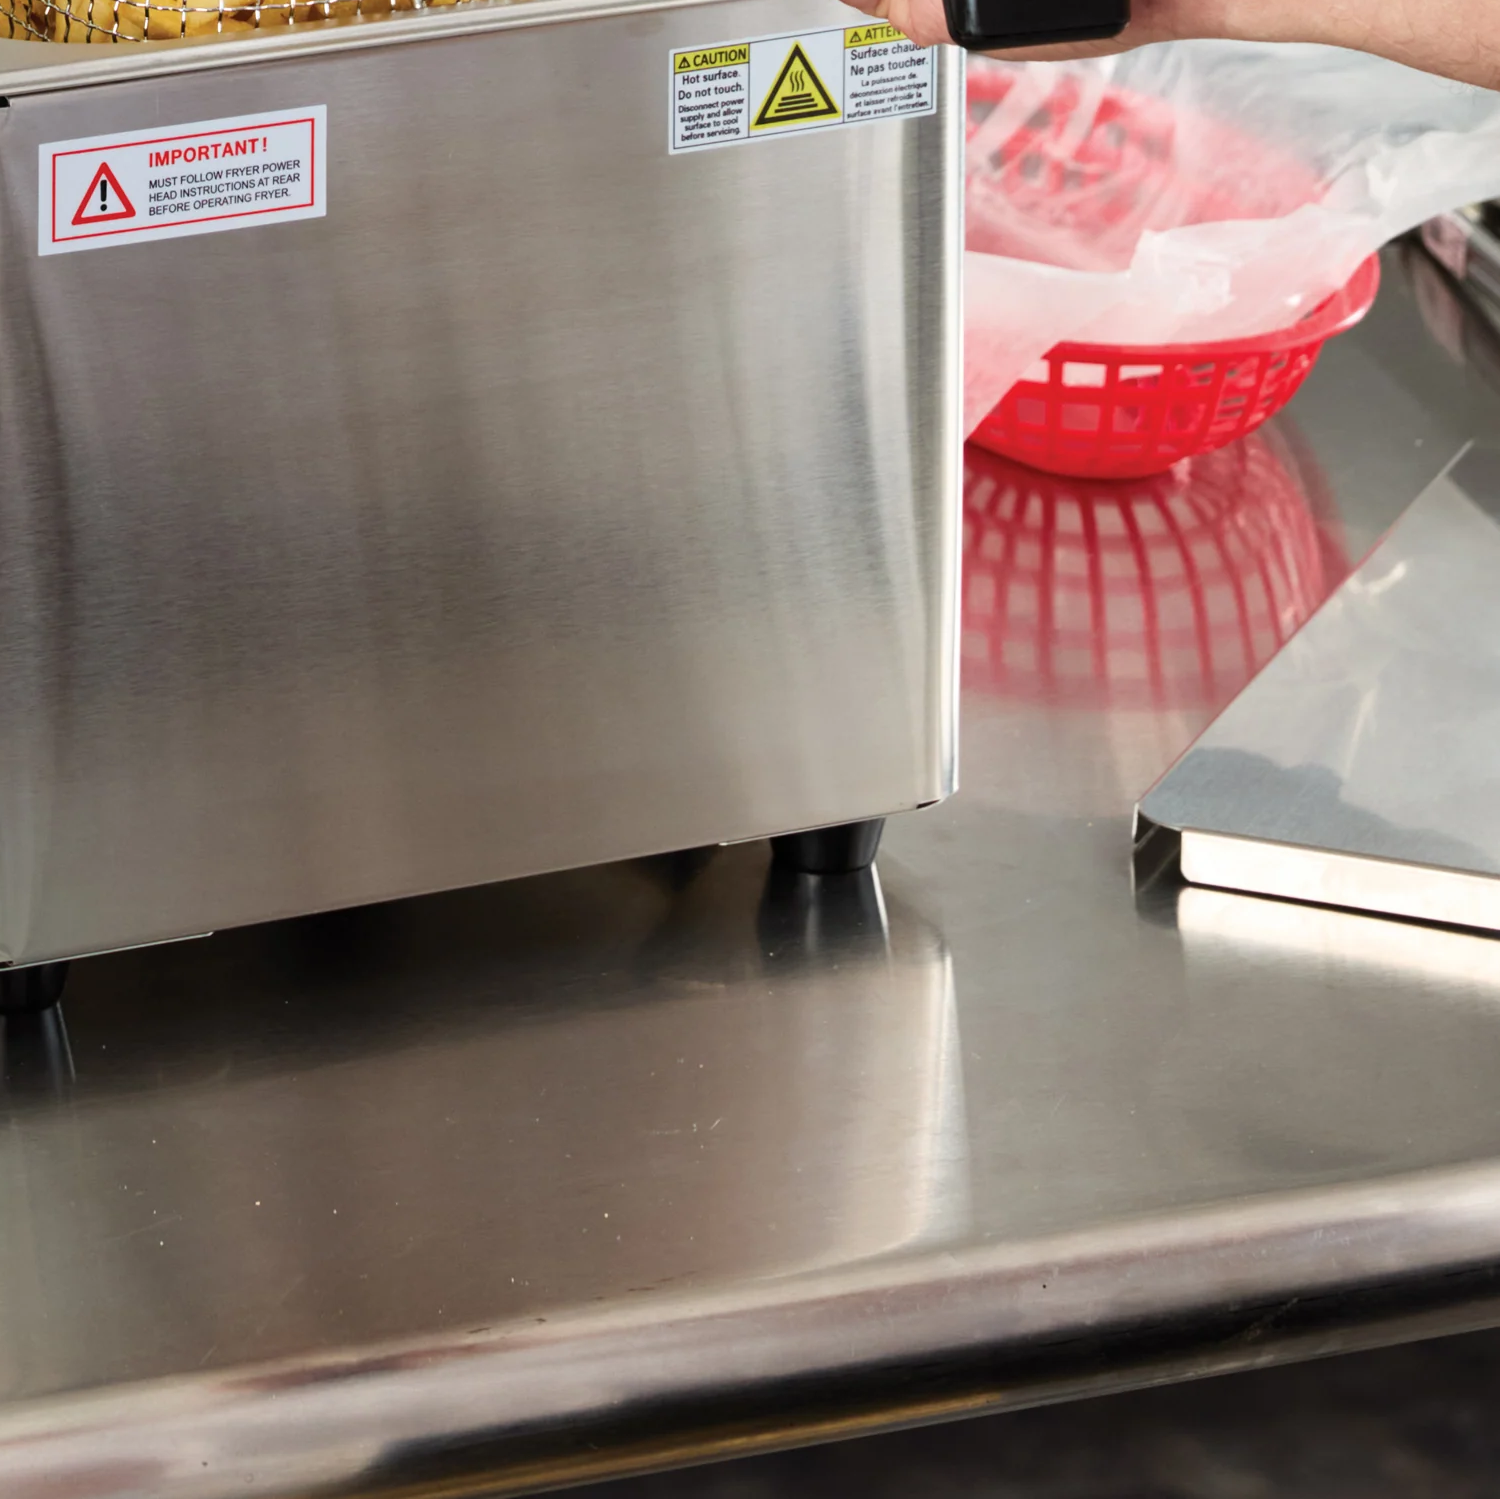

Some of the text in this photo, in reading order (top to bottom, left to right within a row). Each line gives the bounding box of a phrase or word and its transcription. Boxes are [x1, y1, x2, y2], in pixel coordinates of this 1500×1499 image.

[864, 25, 901, 41] ATTEN
[693, 47, 747, 67] CAUTION
[850, 47, 888, 60] Surface
[850, 57, 929, 76] Ne pas toucher.
[682, 70, 741, 85] Hot surface.
[871, 75, 906, 86] puissance
[678, 82, 744, 100] Do not touch.
[678, 98, 745, 113] Disconnect power
[863, 98, 885, 106] laisser
[887, 93, 914, 103] refroidir
[680, 108, 743, 123] supply and allow
[847, 109, 871, 119] surface
[873, 106, 892, 115] avant
[684, 121, 711, 131] surface
[722, 116, 739, 125] cool
[681, 132, 705, 141] before
[149, 159, 300, 189] MUST FOLLOW FRYER POWER
[149, 173, 300, 202] HEAD INSTRUCTIONS AT REAR
[149, 187, 291, 216] BEFORE OPERATING FRYER.
